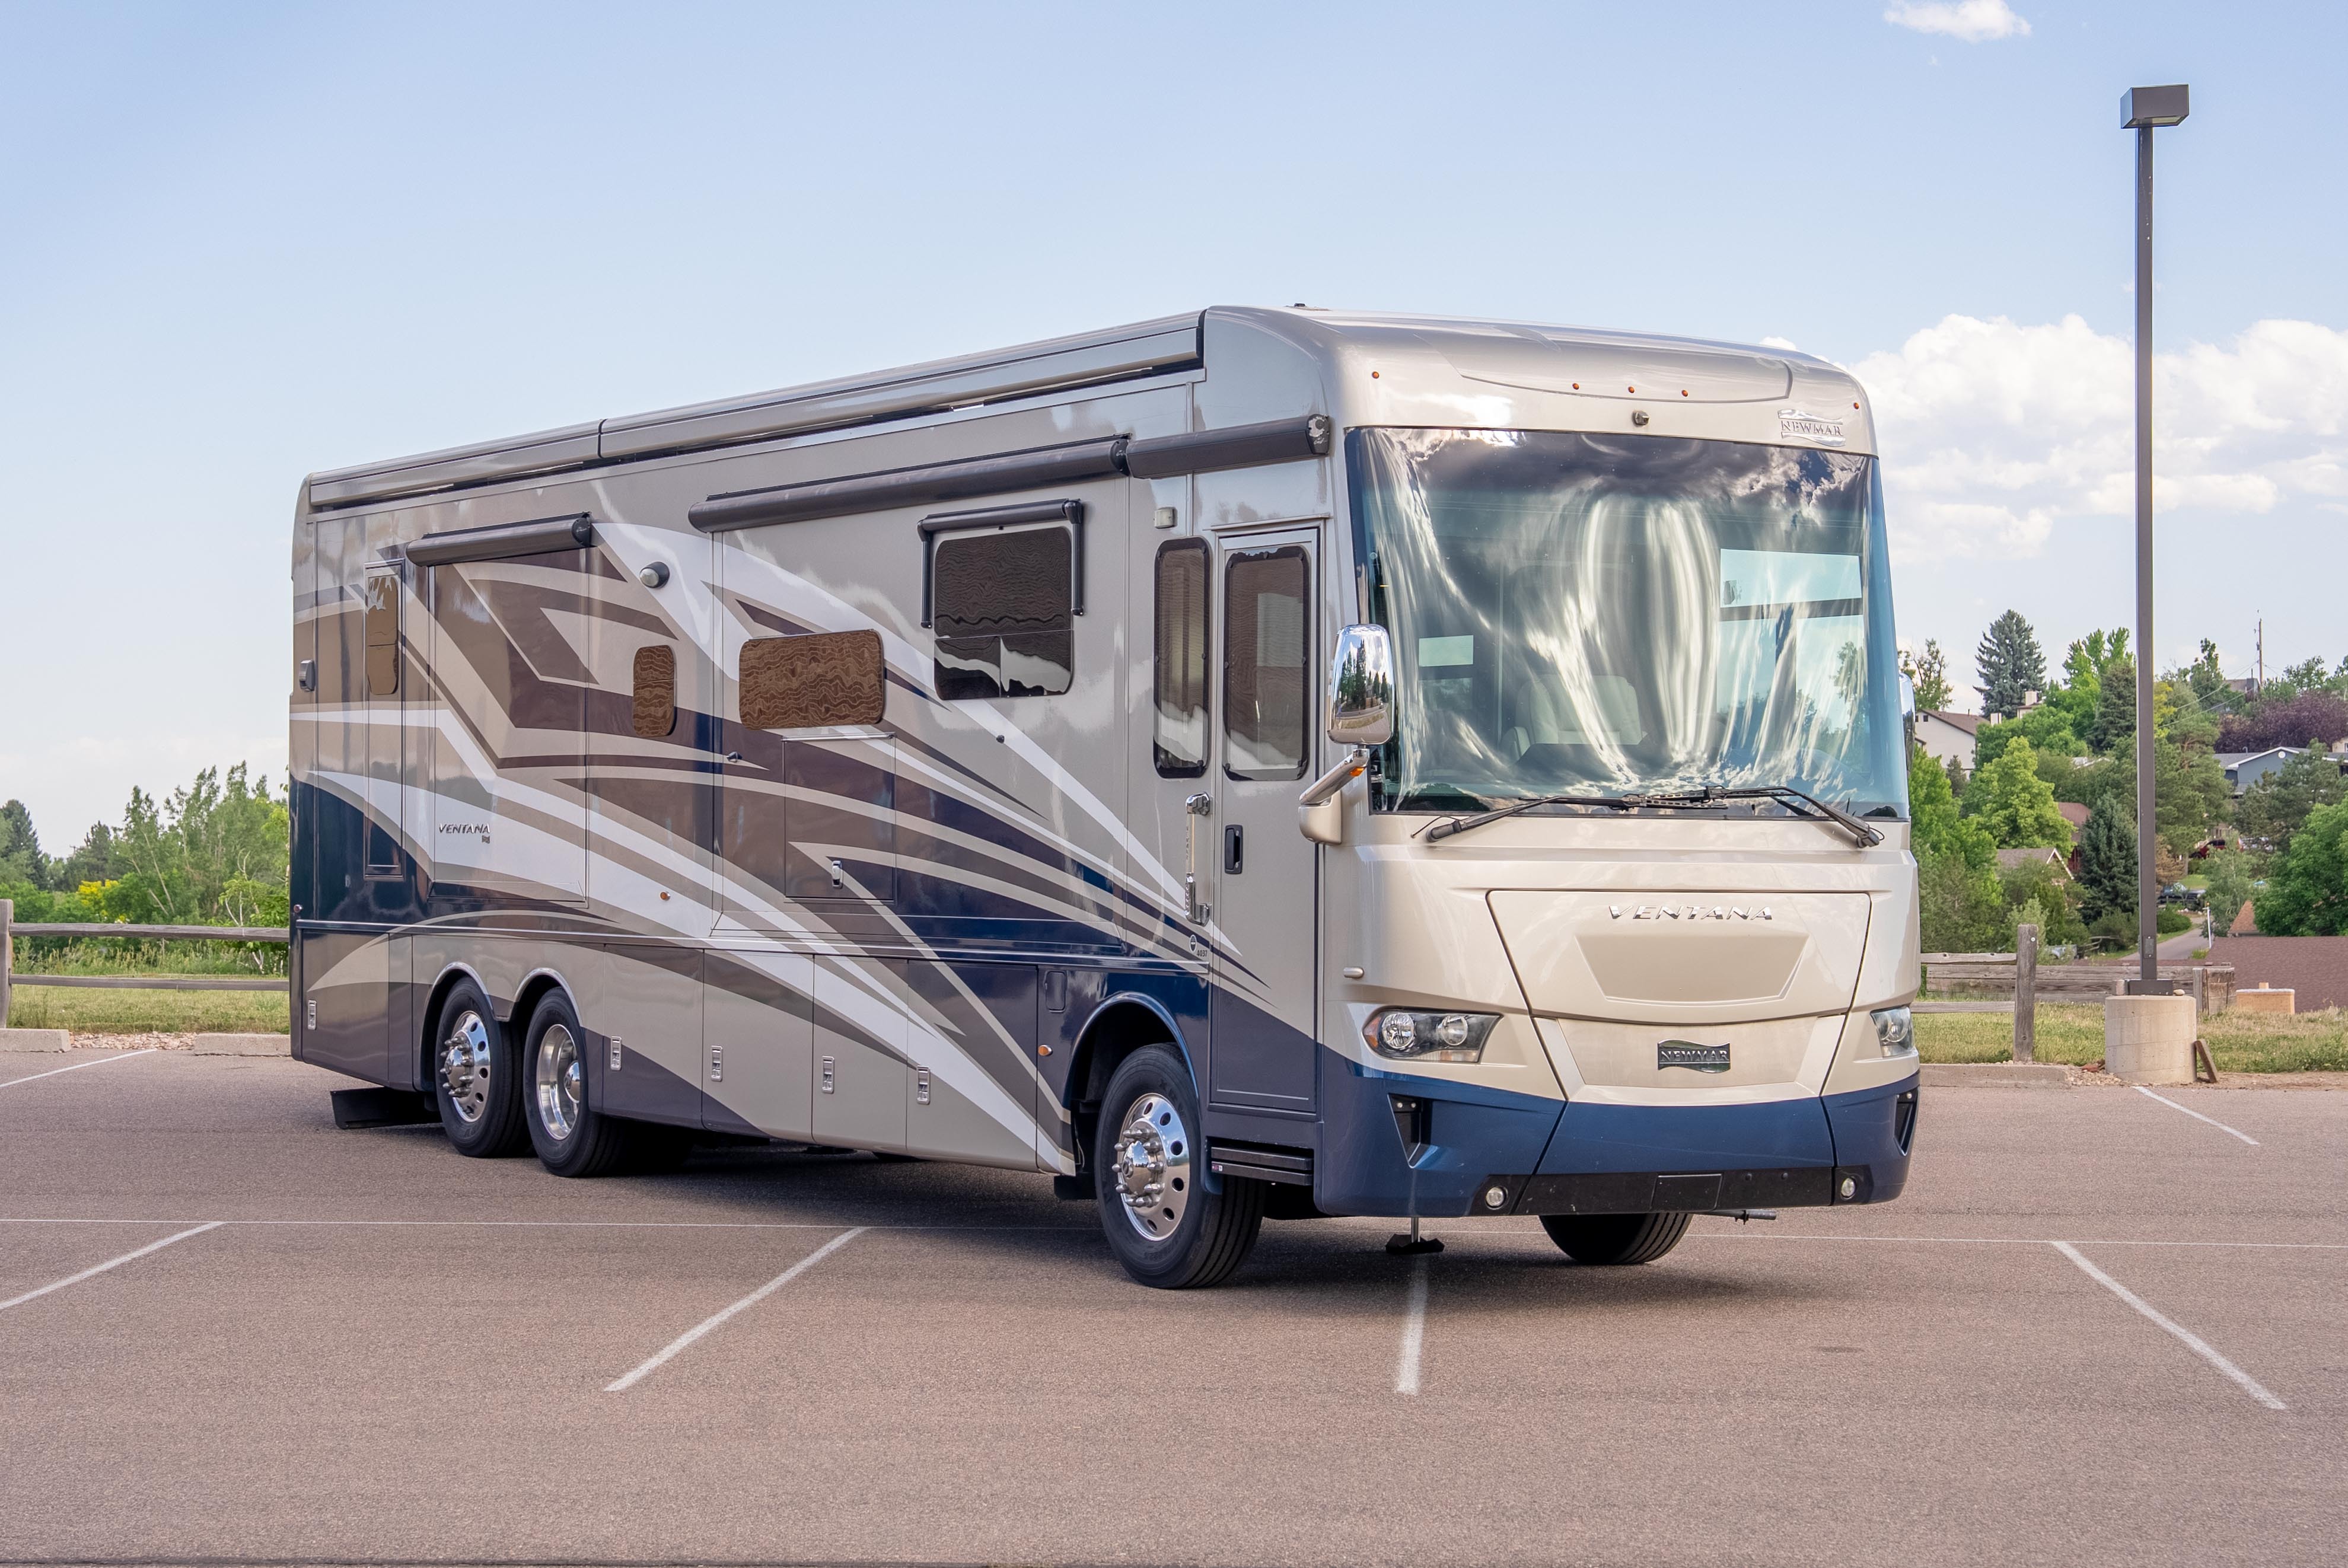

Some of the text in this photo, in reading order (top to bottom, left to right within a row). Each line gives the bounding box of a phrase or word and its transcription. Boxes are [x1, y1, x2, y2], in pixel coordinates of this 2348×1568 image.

[1781, 420, 1844, 436] NEWMAR
[439, 823, 490, 834] VENTANA
[1608, 906, 1772, 920] VENTANA
[1660, 1050, 1730, 1062] NEWMAR
